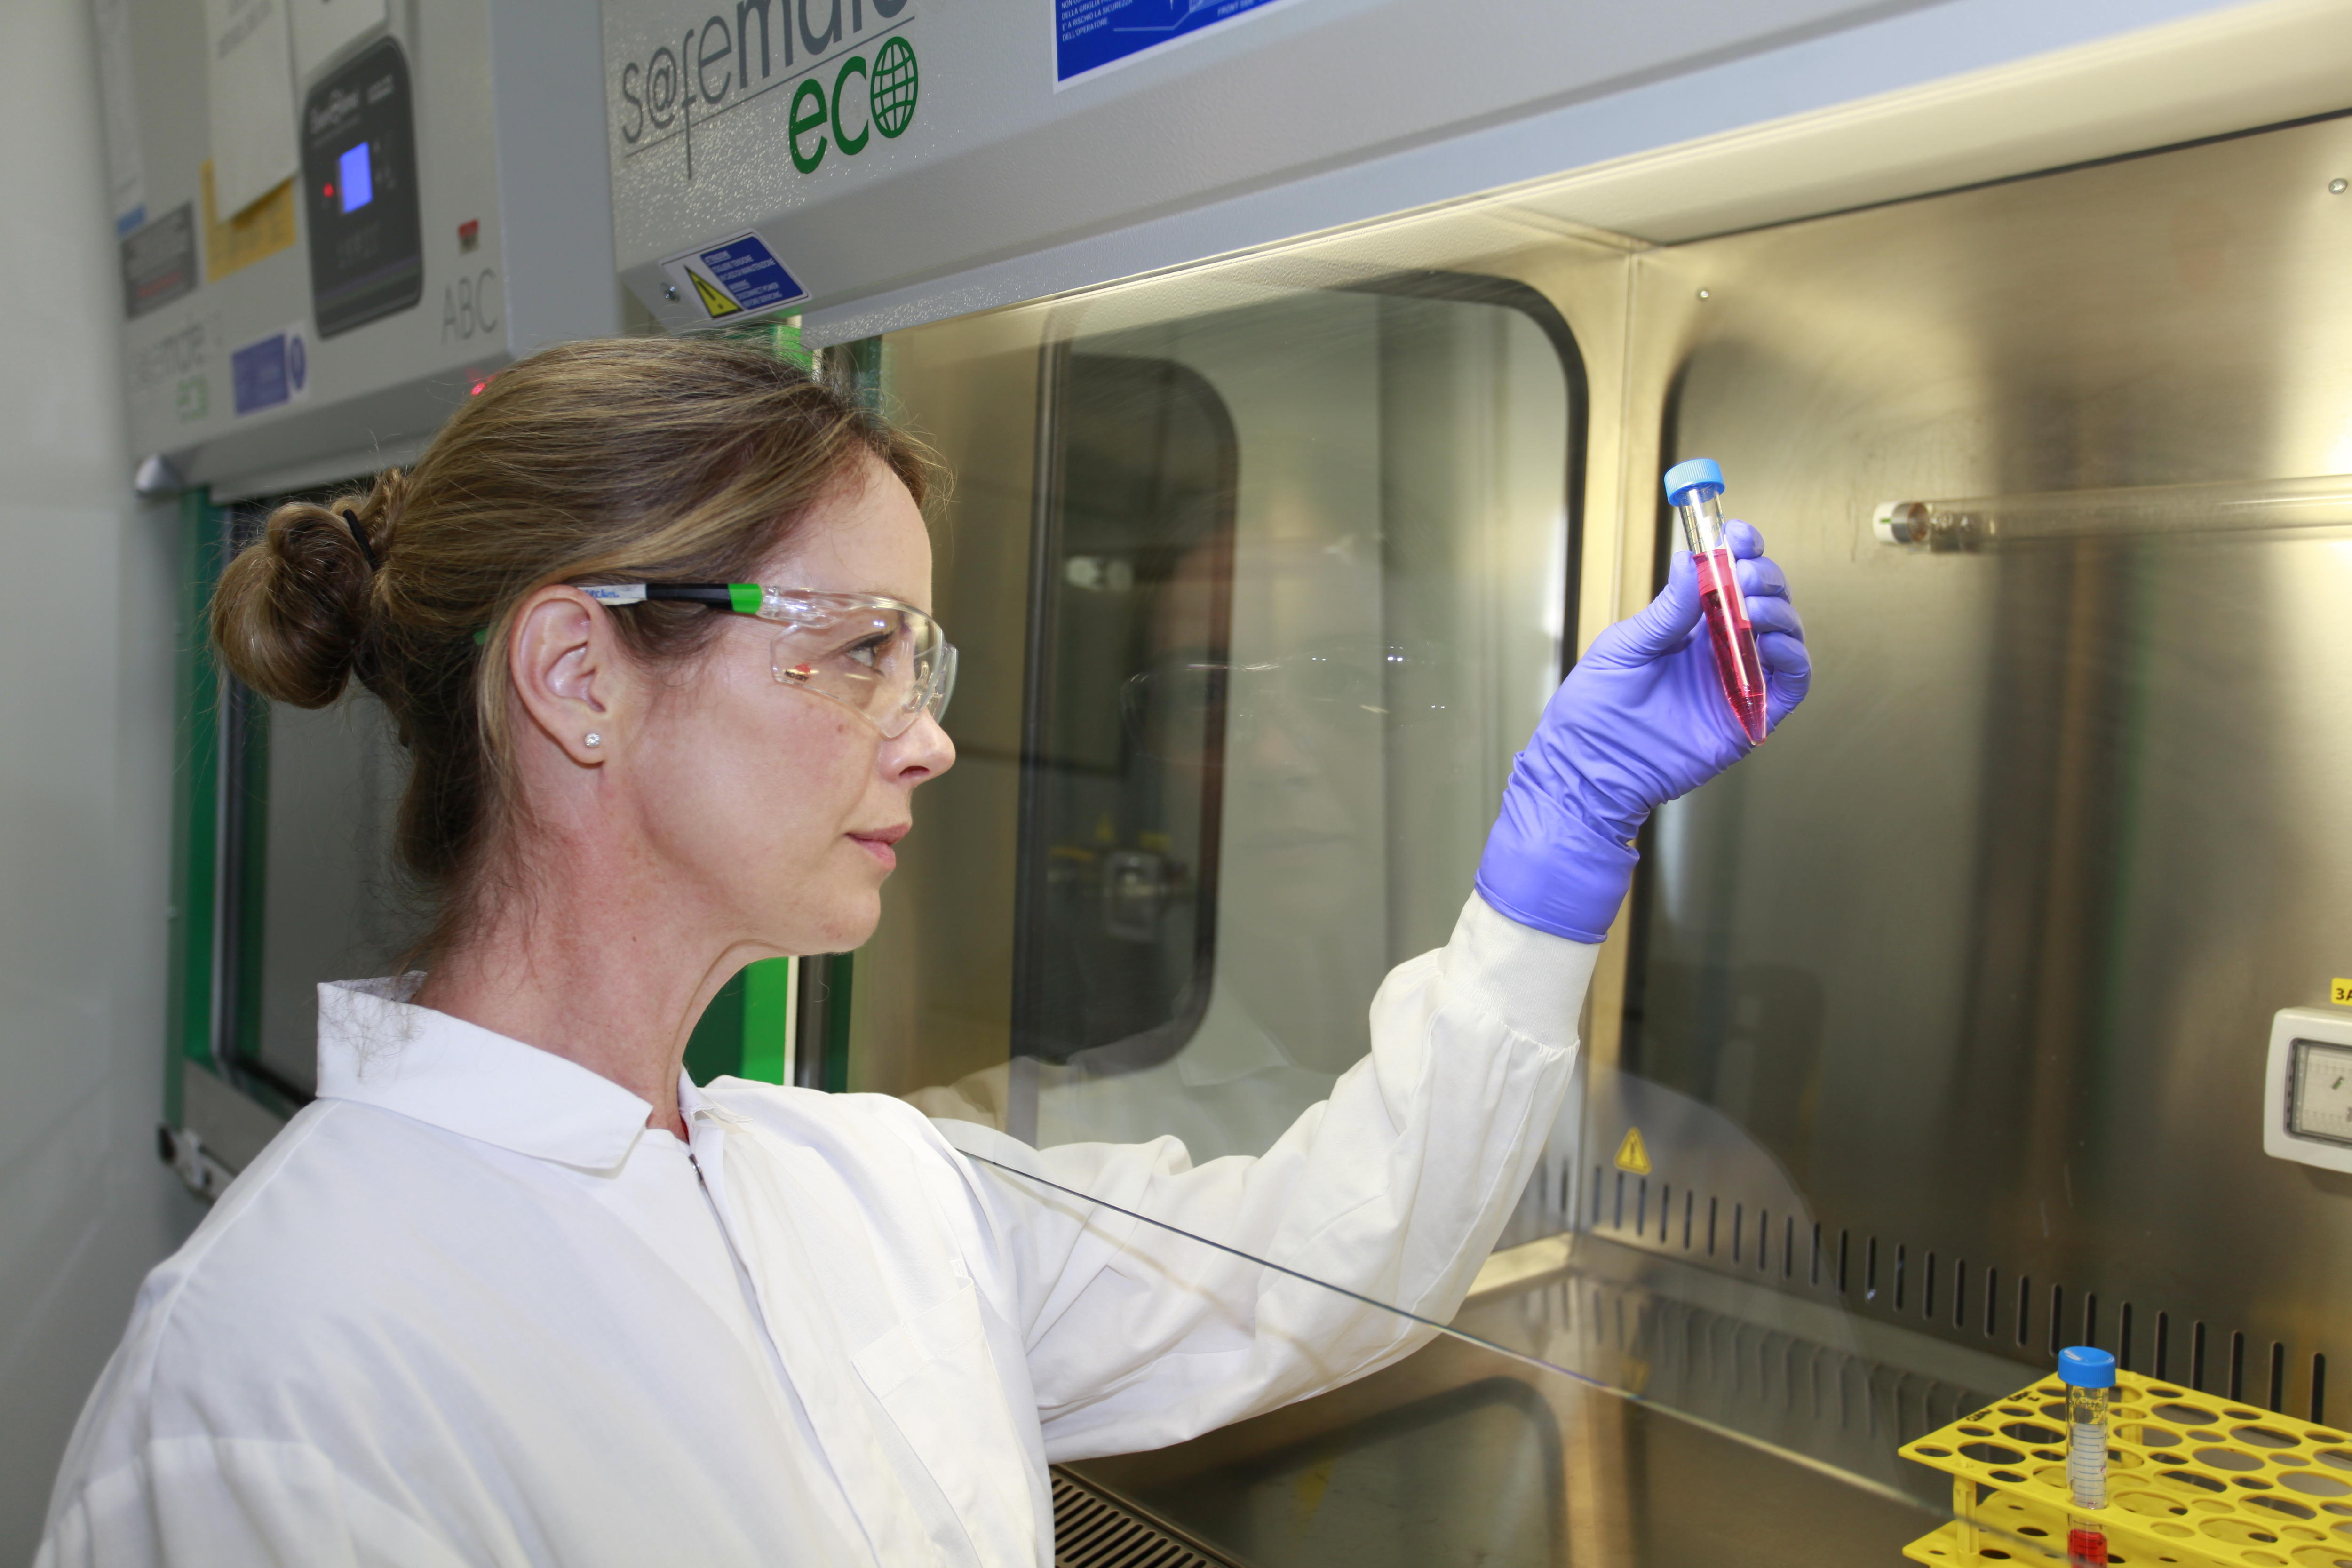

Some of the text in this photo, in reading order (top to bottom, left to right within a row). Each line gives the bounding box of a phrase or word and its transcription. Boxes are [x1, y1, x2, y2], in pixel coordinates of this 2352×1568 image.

[1062, 0, 1100, 21] DELLA GRIGLIA
[1067, 21, 1072, 29] A
[1073, 13, 1094, 27] RISCHIO
[1094, 8, 1102, 18] LA
[1062, 17, 1108, 42] DELL'OPERATORE
[440, 268, 498, 346] ABC
